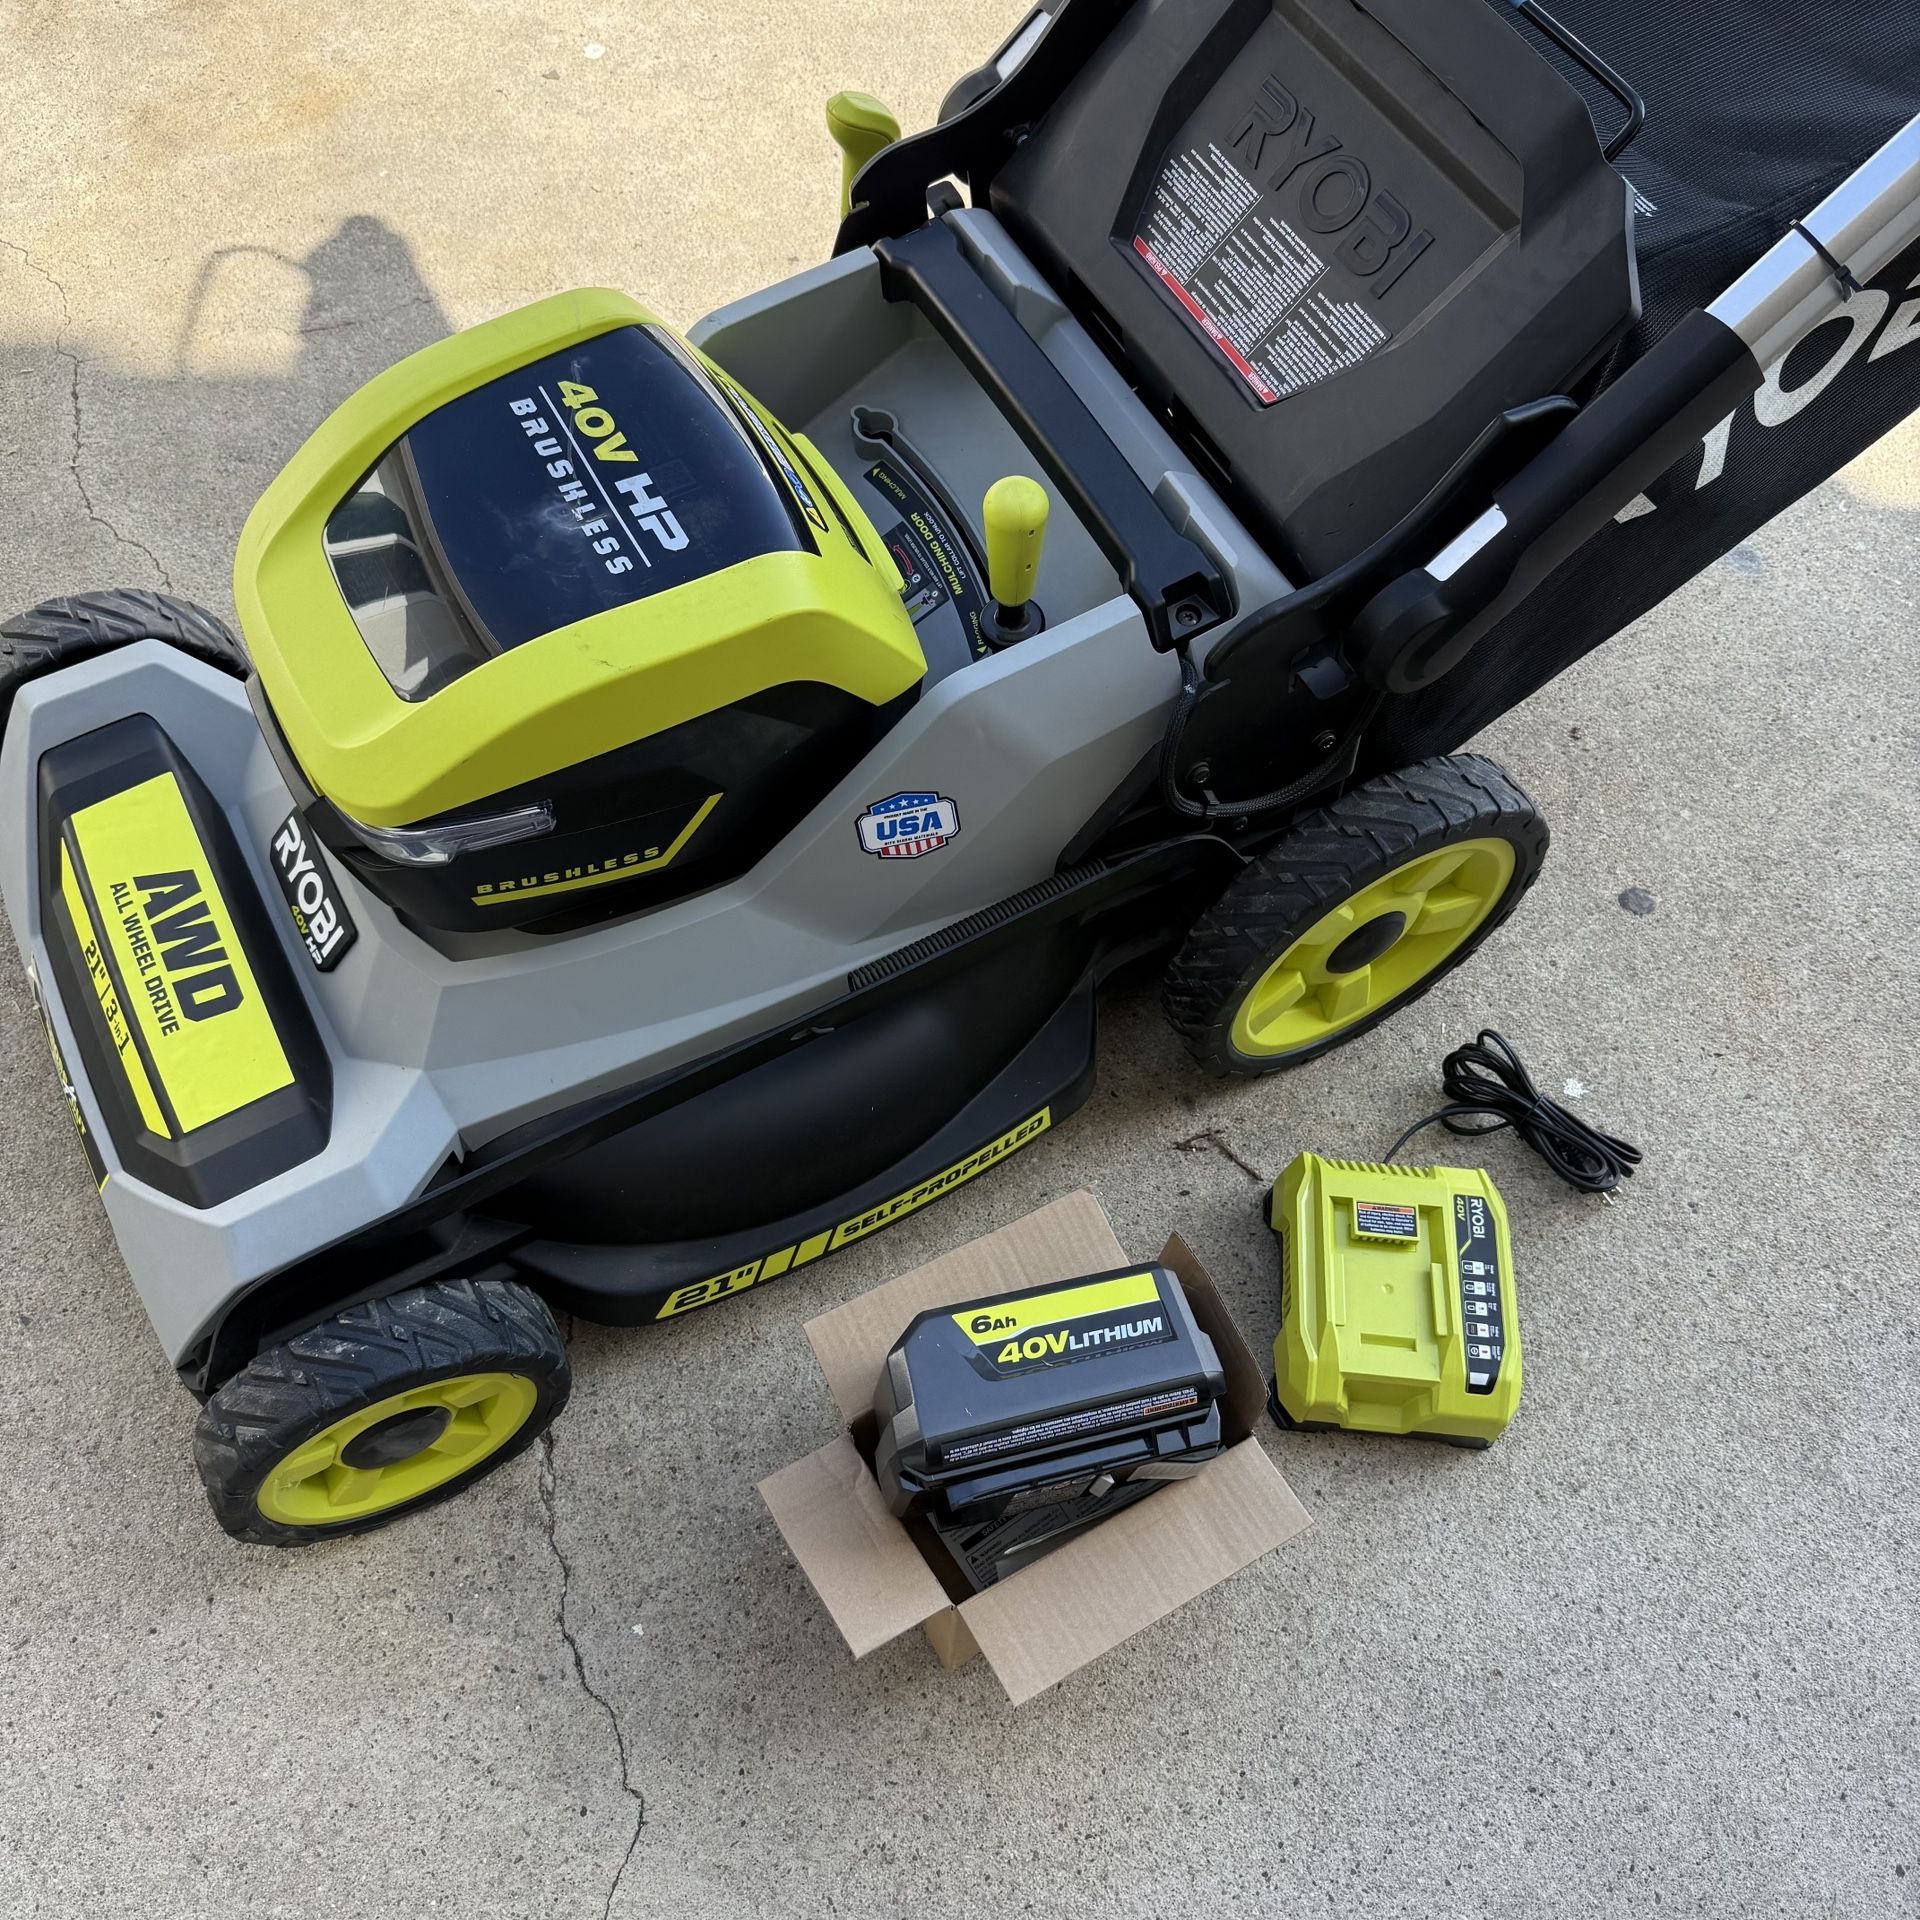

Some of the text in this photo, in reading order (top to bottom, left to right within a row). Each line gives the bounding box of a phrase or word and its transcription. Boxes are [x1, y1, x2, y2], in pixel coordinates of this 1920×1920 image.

[1225, 73, 1436, 299] RYOBI
[1146, 252, 1164, 273] PELIGRO
[1202, 317, 1220, 338] DANGER
[1248, 372, 1266, 392] DANGER
[509, 397, 634, 575] BRUSHLESS
[557, 380, 690, 551] 40V HP
[878, 471, 906, 500] MULCHING
[910, 511, 963, 594] MULCHING DOOR
[923, 511, 966, 578] LIFT COLLAR TO UNLOCK
[876, 811, 942, 841] USA
[275, 816, 344, 958] RYOBI
[476, 846, 661, 896] BRUSHLESS
[109, 882, 180, 1037] ALL WHEEL DRIVE
[133, 869, 244, 1022] AWD
[291, 905, 323, 965] 40V HP
[84, 939, 131, 1056] 21" 3-in-1
[671, 1115, 1046, 1310] 21" SELF-PROPELLED
[1457, 1196, 1466, 1221] 40V
[1470, 1199, 1486, 1239] RYOBI
[970, 1312, 1017, 1334] 6Ah
[996, 1316, 1163, 1363] 40V LITHIUM
